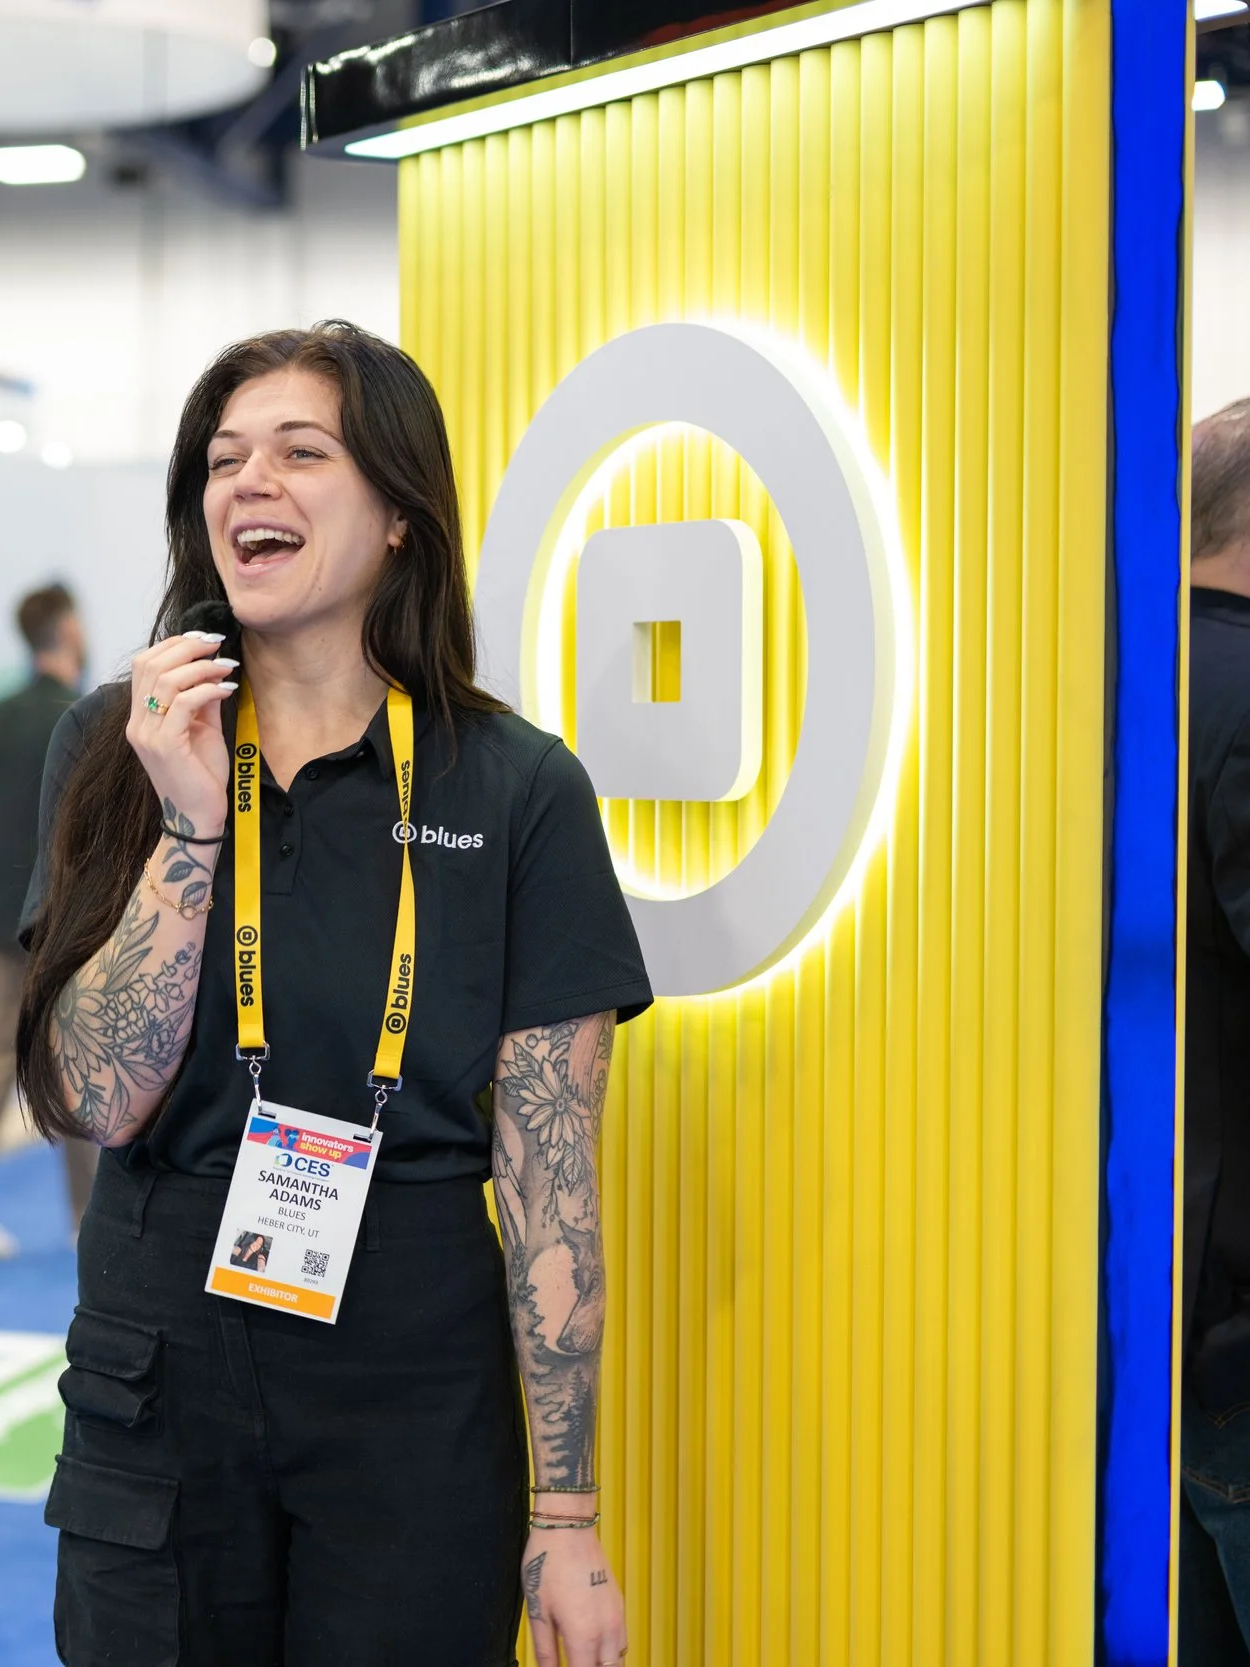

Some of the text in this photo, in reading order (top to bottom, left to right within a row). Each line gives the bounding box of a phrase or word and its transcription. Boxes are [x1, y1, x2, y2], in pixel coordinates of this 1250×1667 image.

[237, 762, 255, 812] blues
[421, 825, 483, 849] blues
[239, 950, 256, 1007] blues
[391, 953, 412, 1010] blues
[299, 1142, 342, 1160] show up
[294, 1157, 331, 1177] CES
[258, 1170, 338, 1201] SAMANTHA
[269, 1188, 322, 1211] ADAMS
[278, 1206, 306, 1221] BLUES
[257, 1216, 285, 1230] HEBER
[307, 1228, 320, 1238] UT
[248, 1283, 299, 1303] EXHIBITOR
